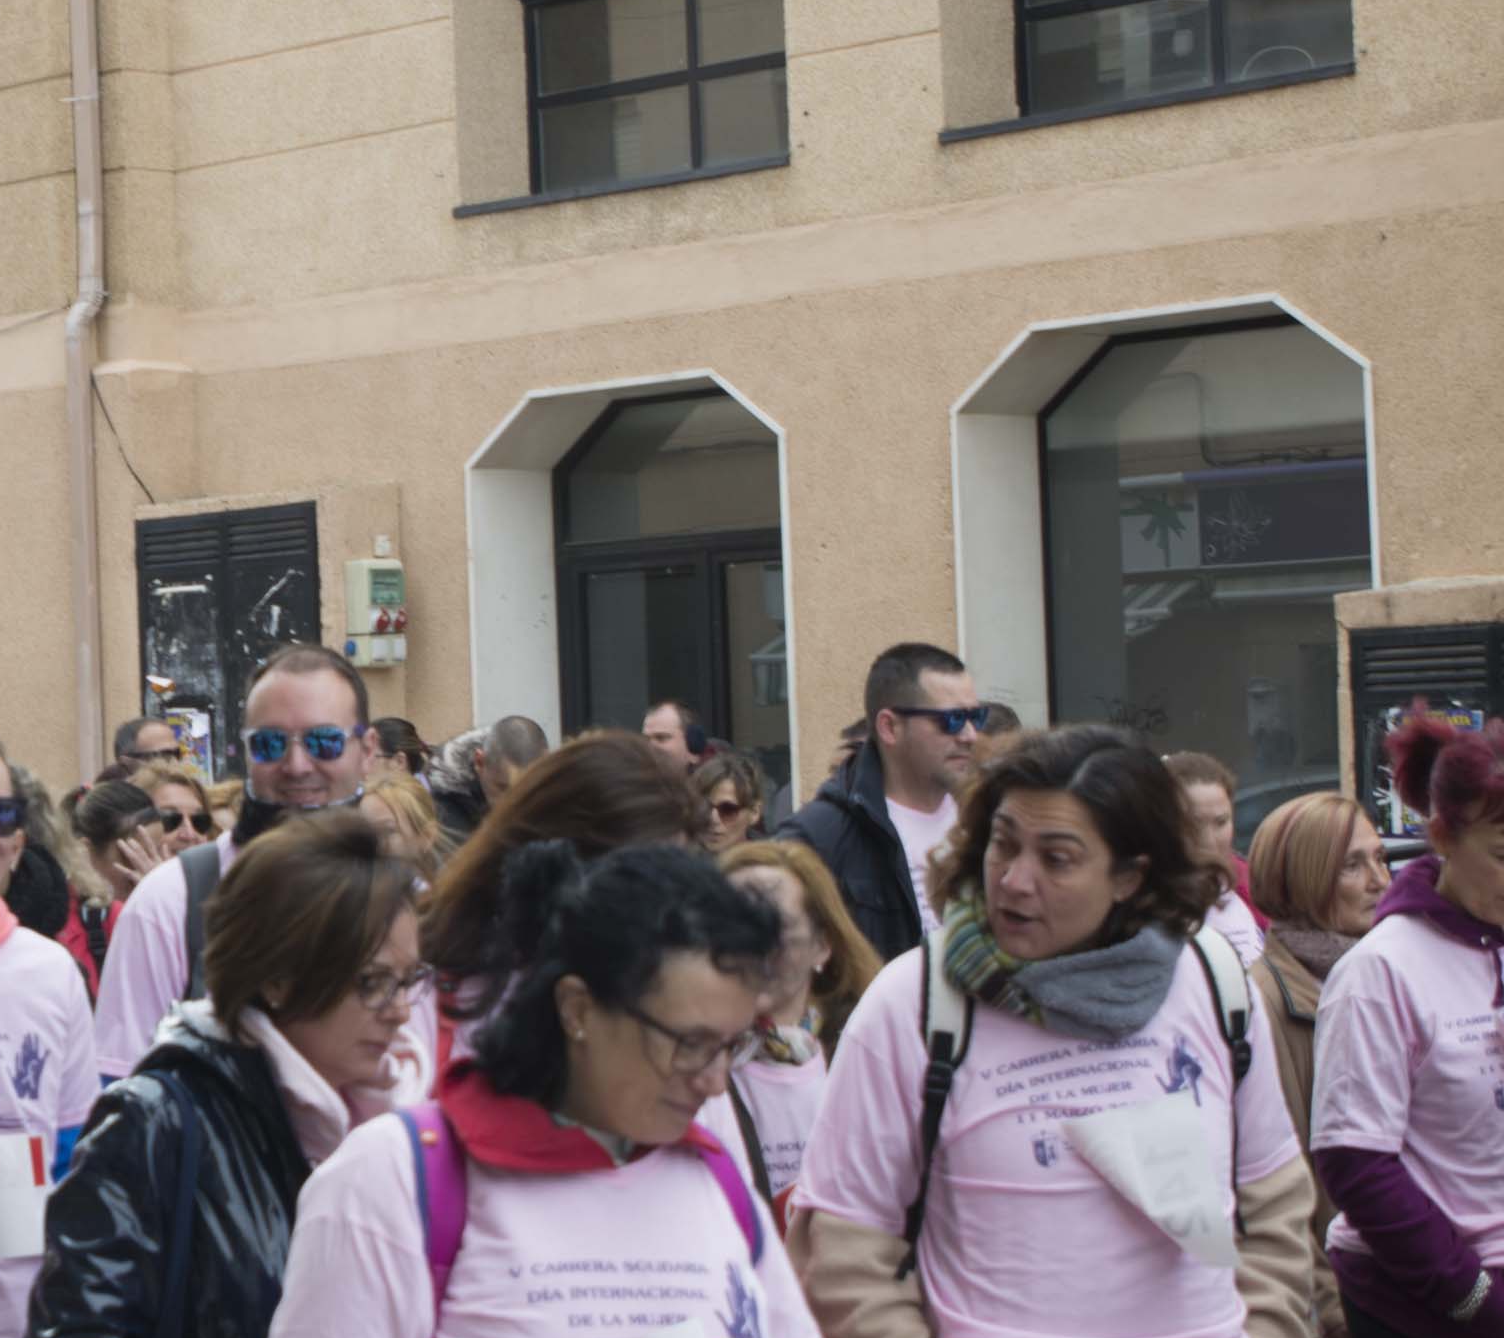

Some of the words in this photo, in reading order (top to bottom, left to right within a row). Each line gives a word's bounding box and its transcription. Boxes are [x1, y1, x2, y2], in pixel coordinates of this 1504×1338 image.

[996, 1047, 1073, 1076] CARRERA
[1076, 1035, 1160, 1058] SOLIDARIA
[1028, 1057, 1152, 1088] INTERNACIONAL
[530, 1262, 617, 1276] CARRERA
[569, 1287, 709, 1301] INTERNACIONAL
